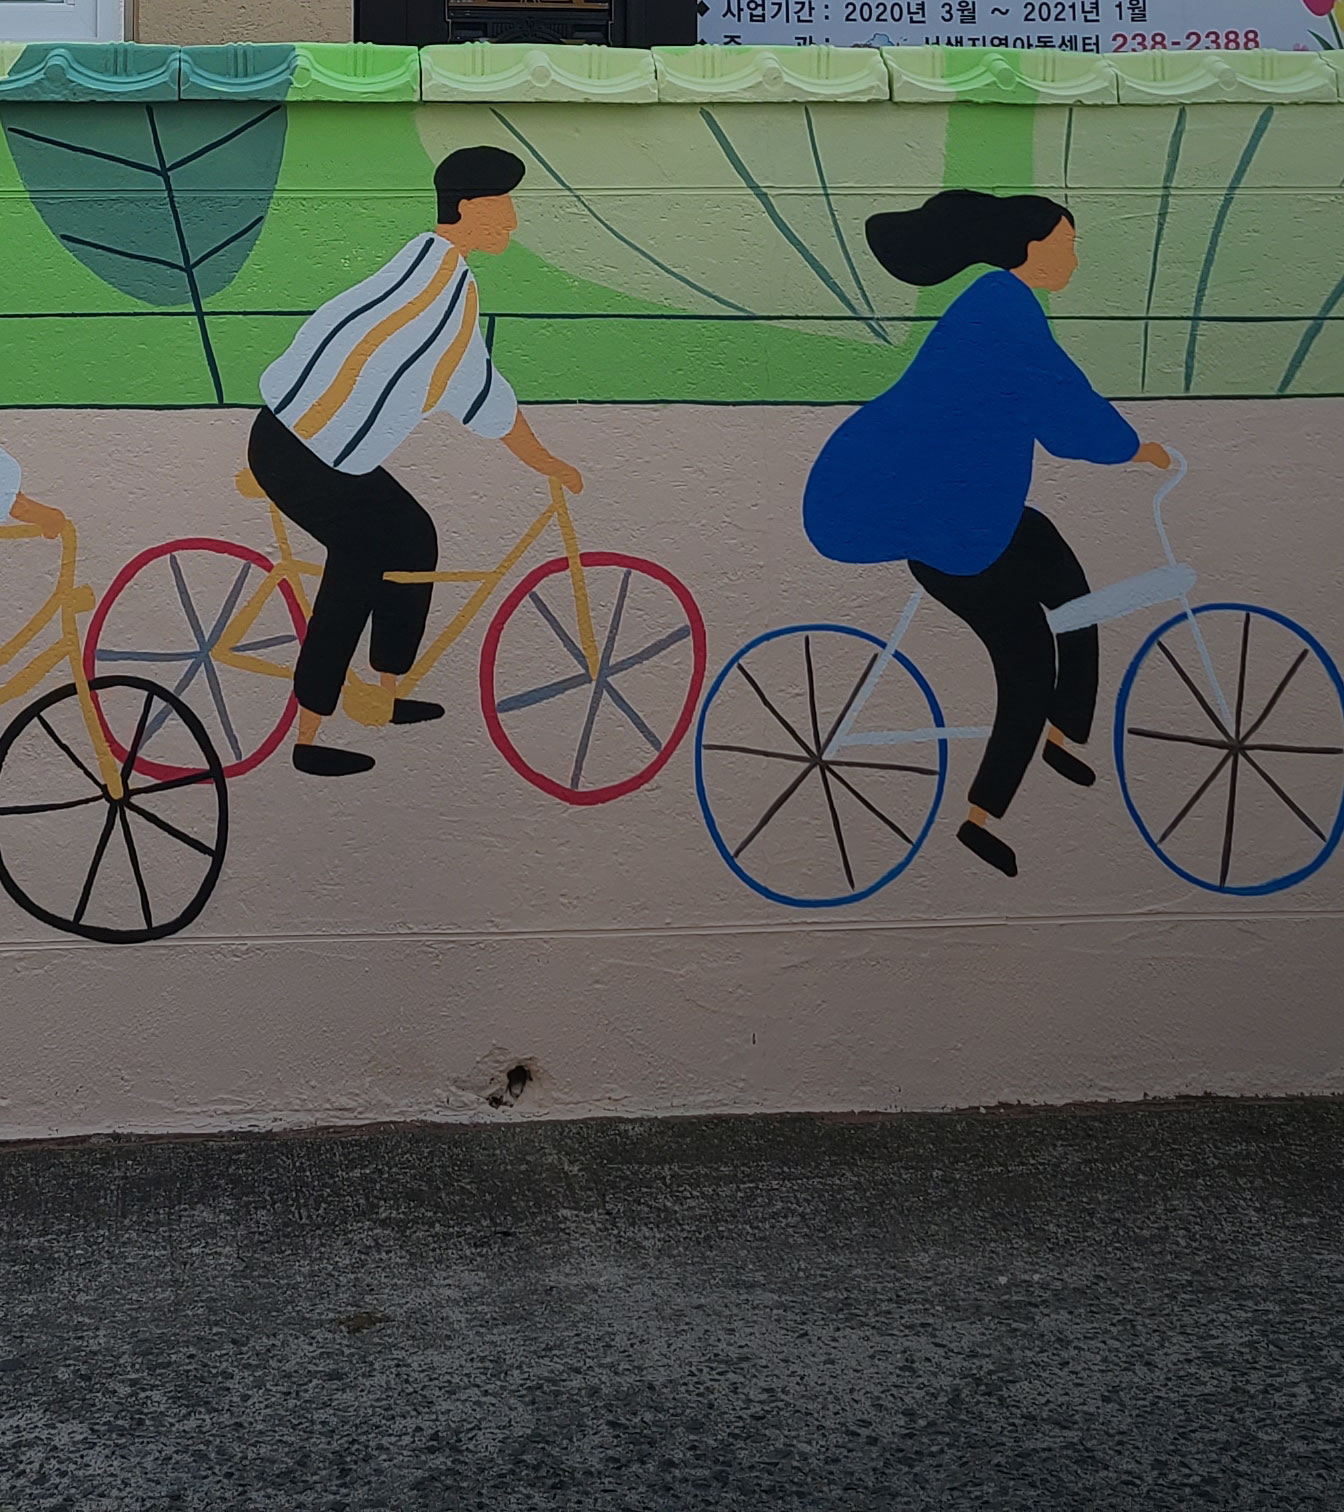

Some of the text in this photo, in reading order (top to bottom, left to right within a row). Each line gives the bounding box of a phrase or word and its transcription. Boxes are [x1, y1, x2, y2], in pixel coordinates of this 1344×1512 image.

[843, 0, 928, 25] 2020년
[940, 0, 978, 25] 3월
[1110, 28, 1261, 53] 238-2388
